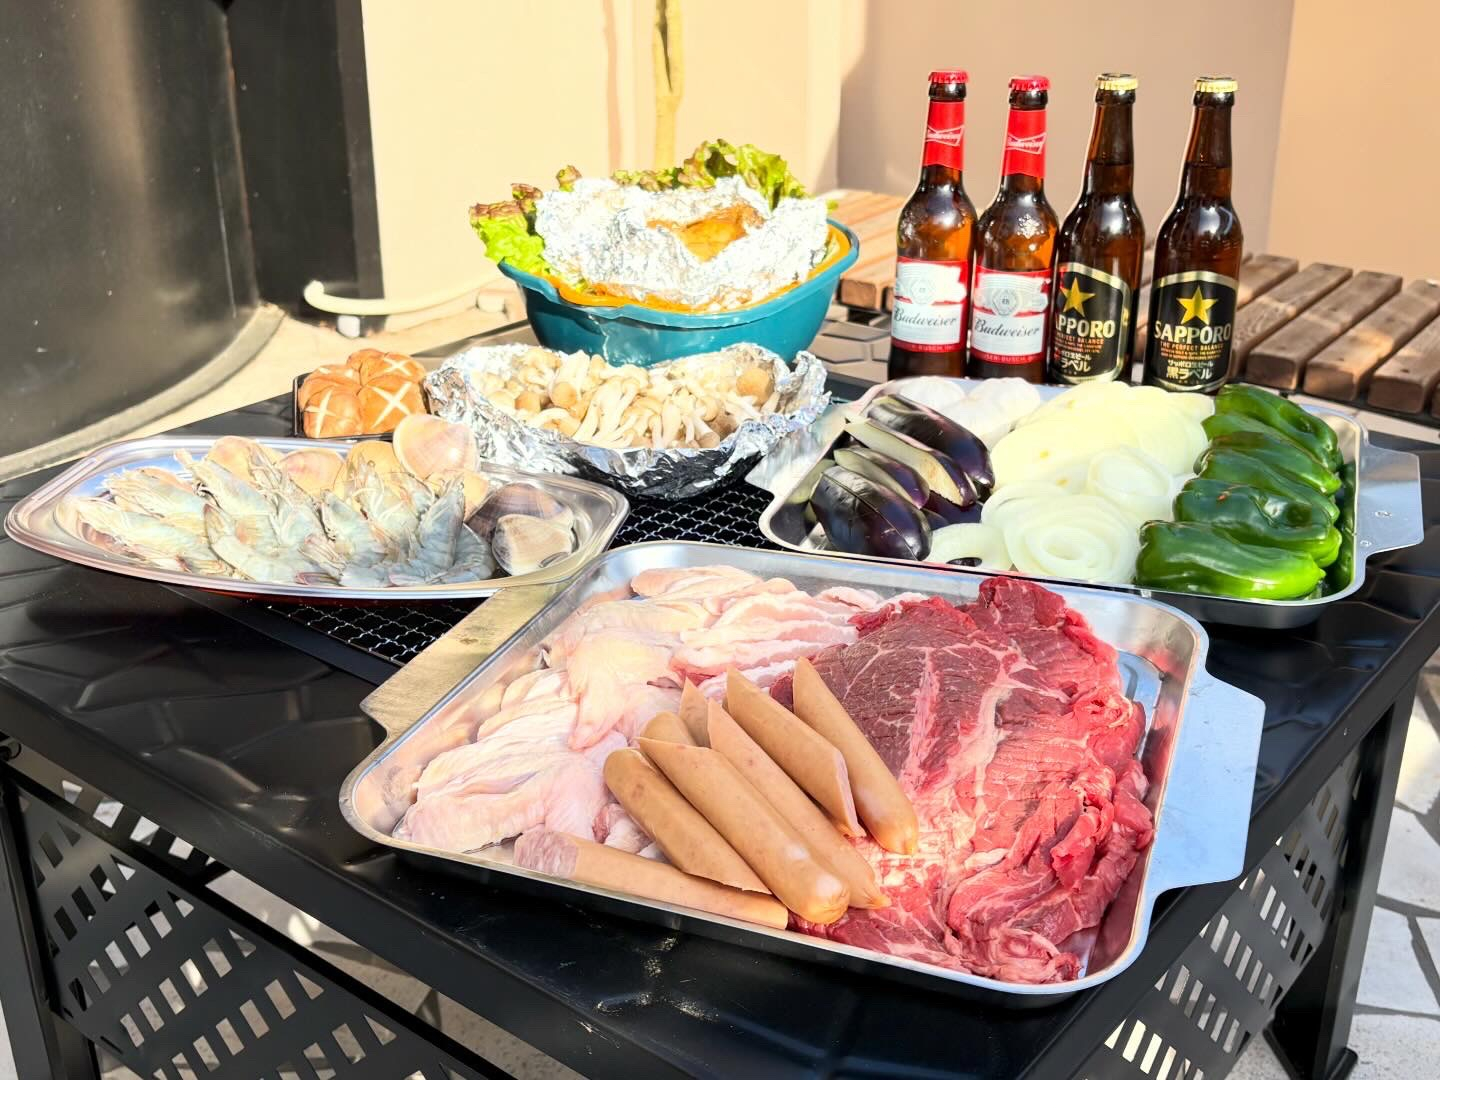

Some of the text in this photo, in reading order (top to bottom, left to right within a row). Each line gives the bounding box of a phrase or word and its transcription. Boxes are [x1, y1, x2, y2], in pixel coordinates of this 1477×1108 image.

[894, 307, 957, 327] Budweiser
[974, 317, 1041, 338] Budweiser
[1154, 320, 1232, 345] SAPPORO
[1166, 365, 1213, 380] 黒ラベル
